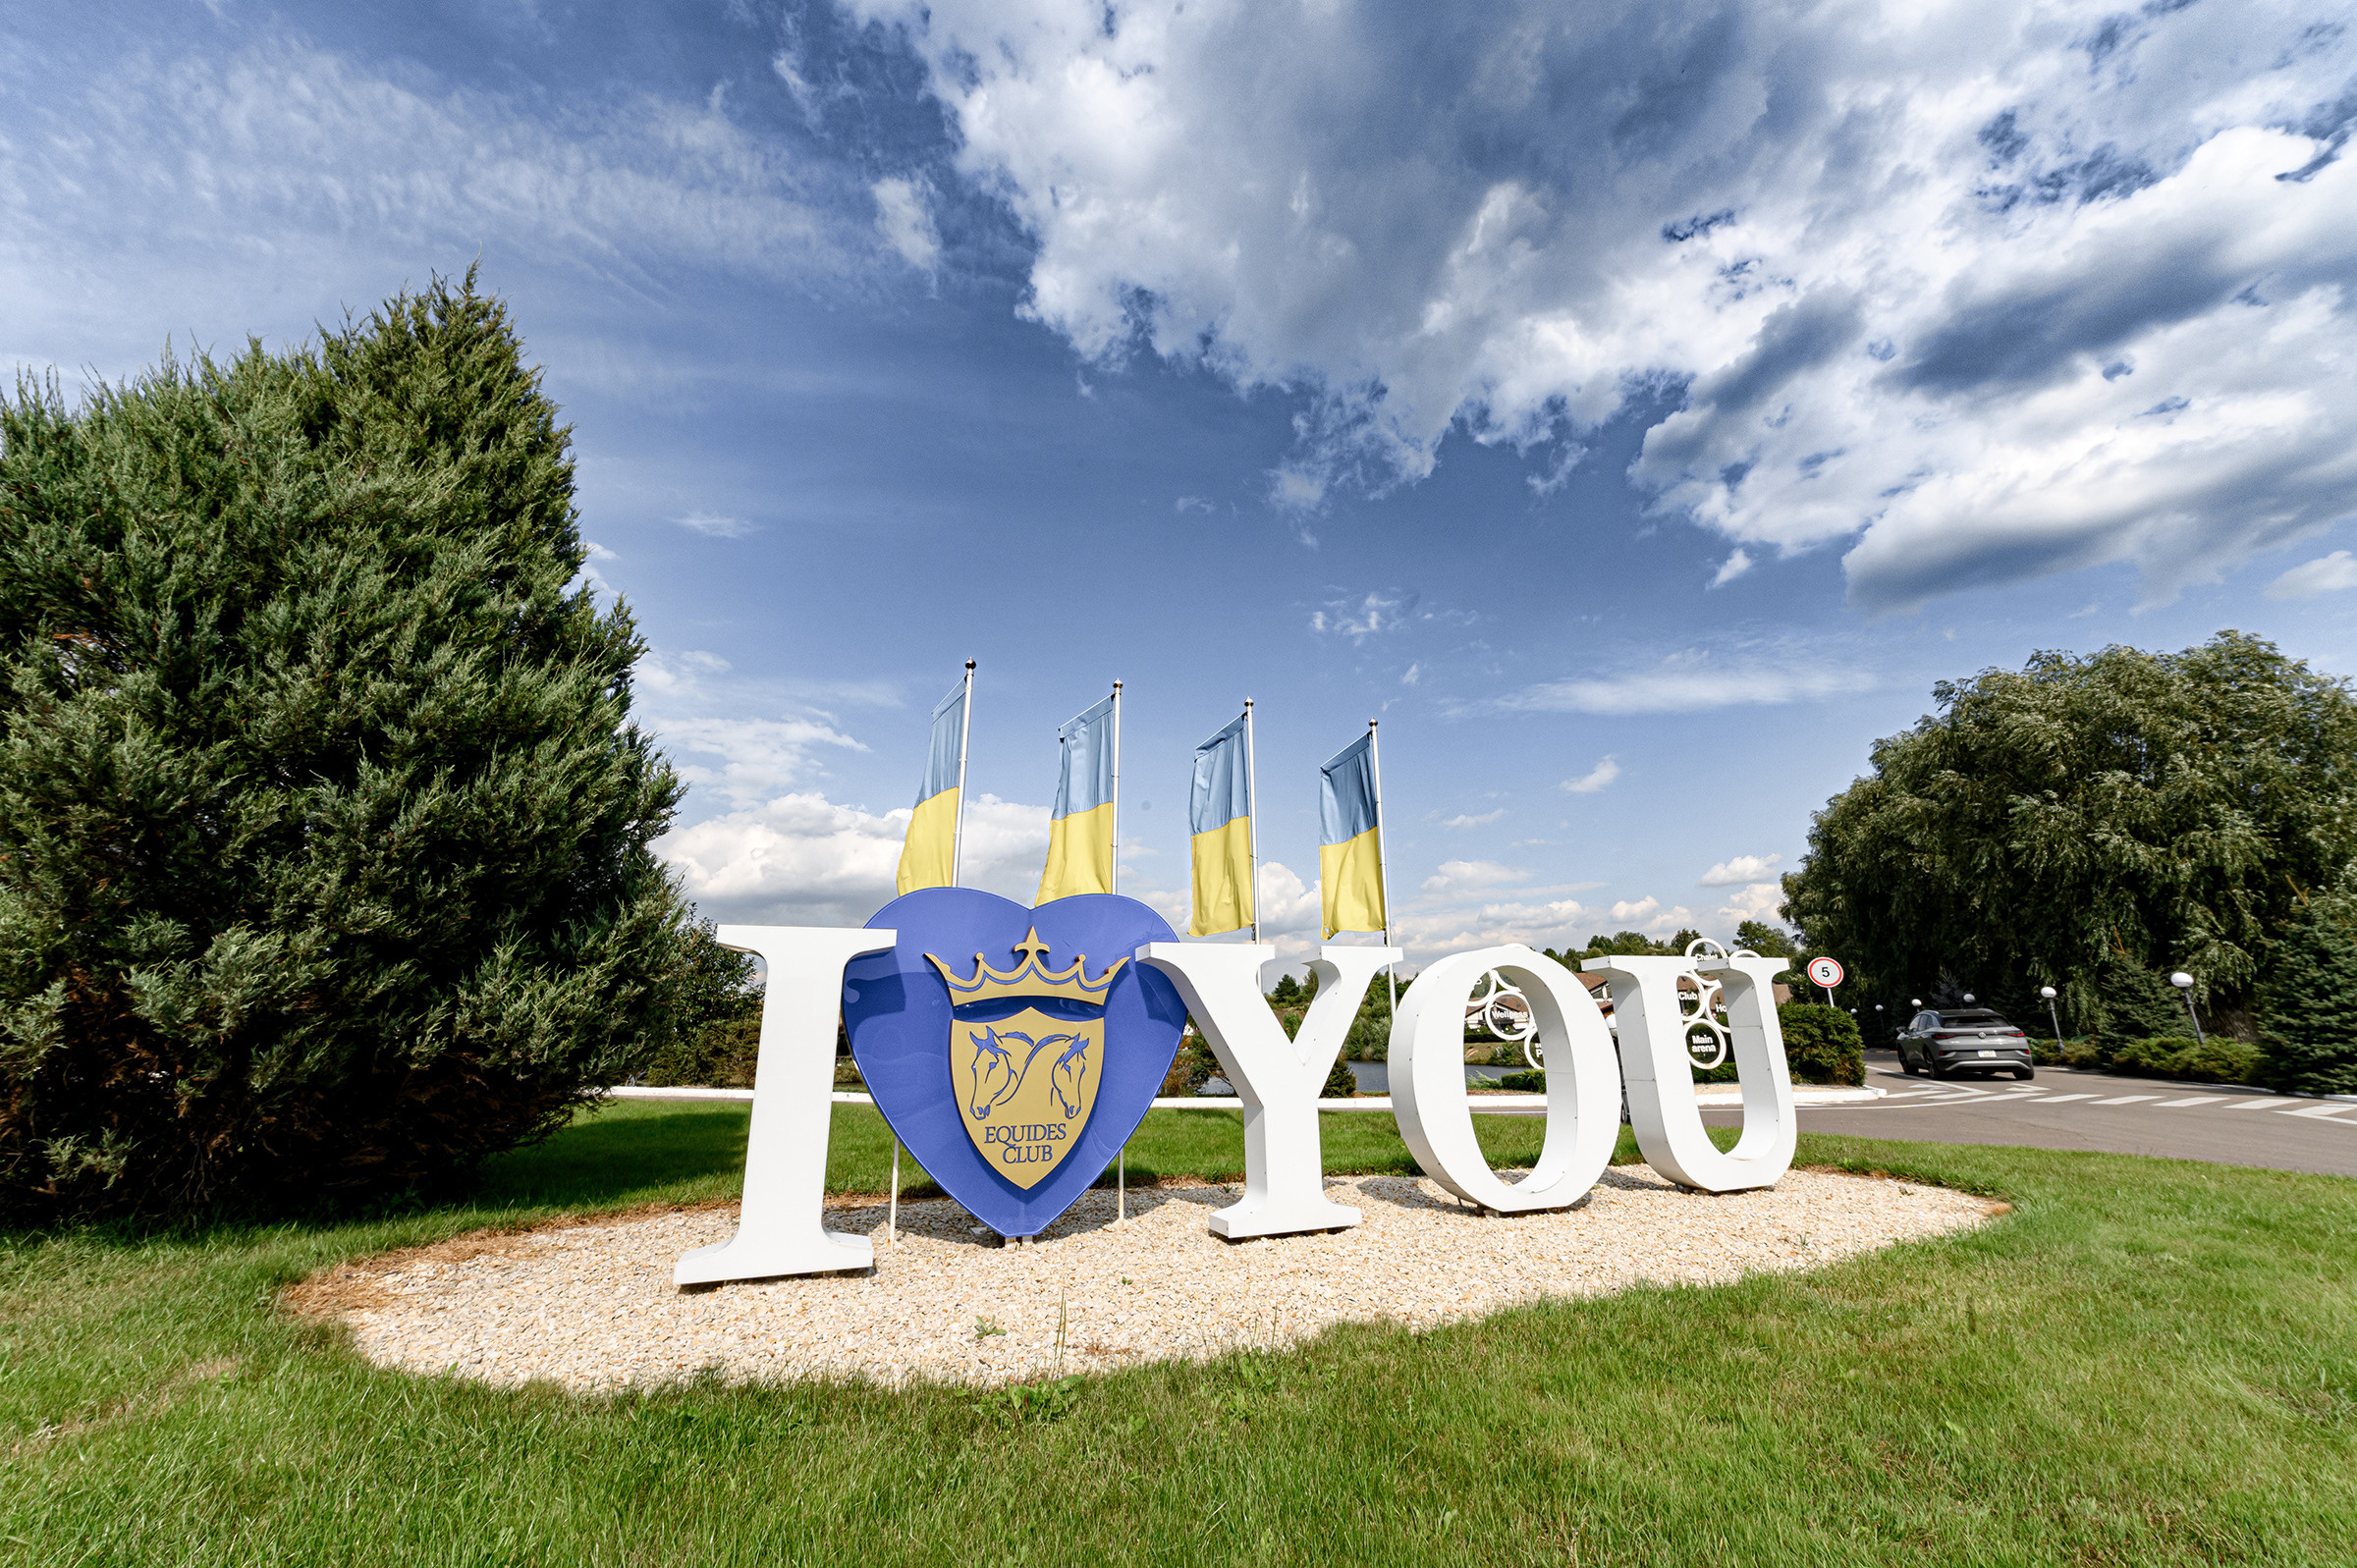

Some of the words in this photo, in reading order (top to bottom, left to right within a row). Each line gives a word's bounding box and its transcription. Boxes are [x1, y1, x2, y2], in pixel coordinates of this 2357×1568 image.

[1822, 966, 1831, 978] 5
[1678, 991, 1698, 1000] Club
[1492, 1008, 1528, 1019] Wellness
[1691, 1034, 1714, 1045] Main
[1691, 1044, 1717, 1053] arena
[673, 925, 898, 1284] I
[1136, 943, 1797, 1239] YOU
[984, 1123, 1067, 1148] EQUIDES
[1003, 1145, 1053, 1163] CLUB
